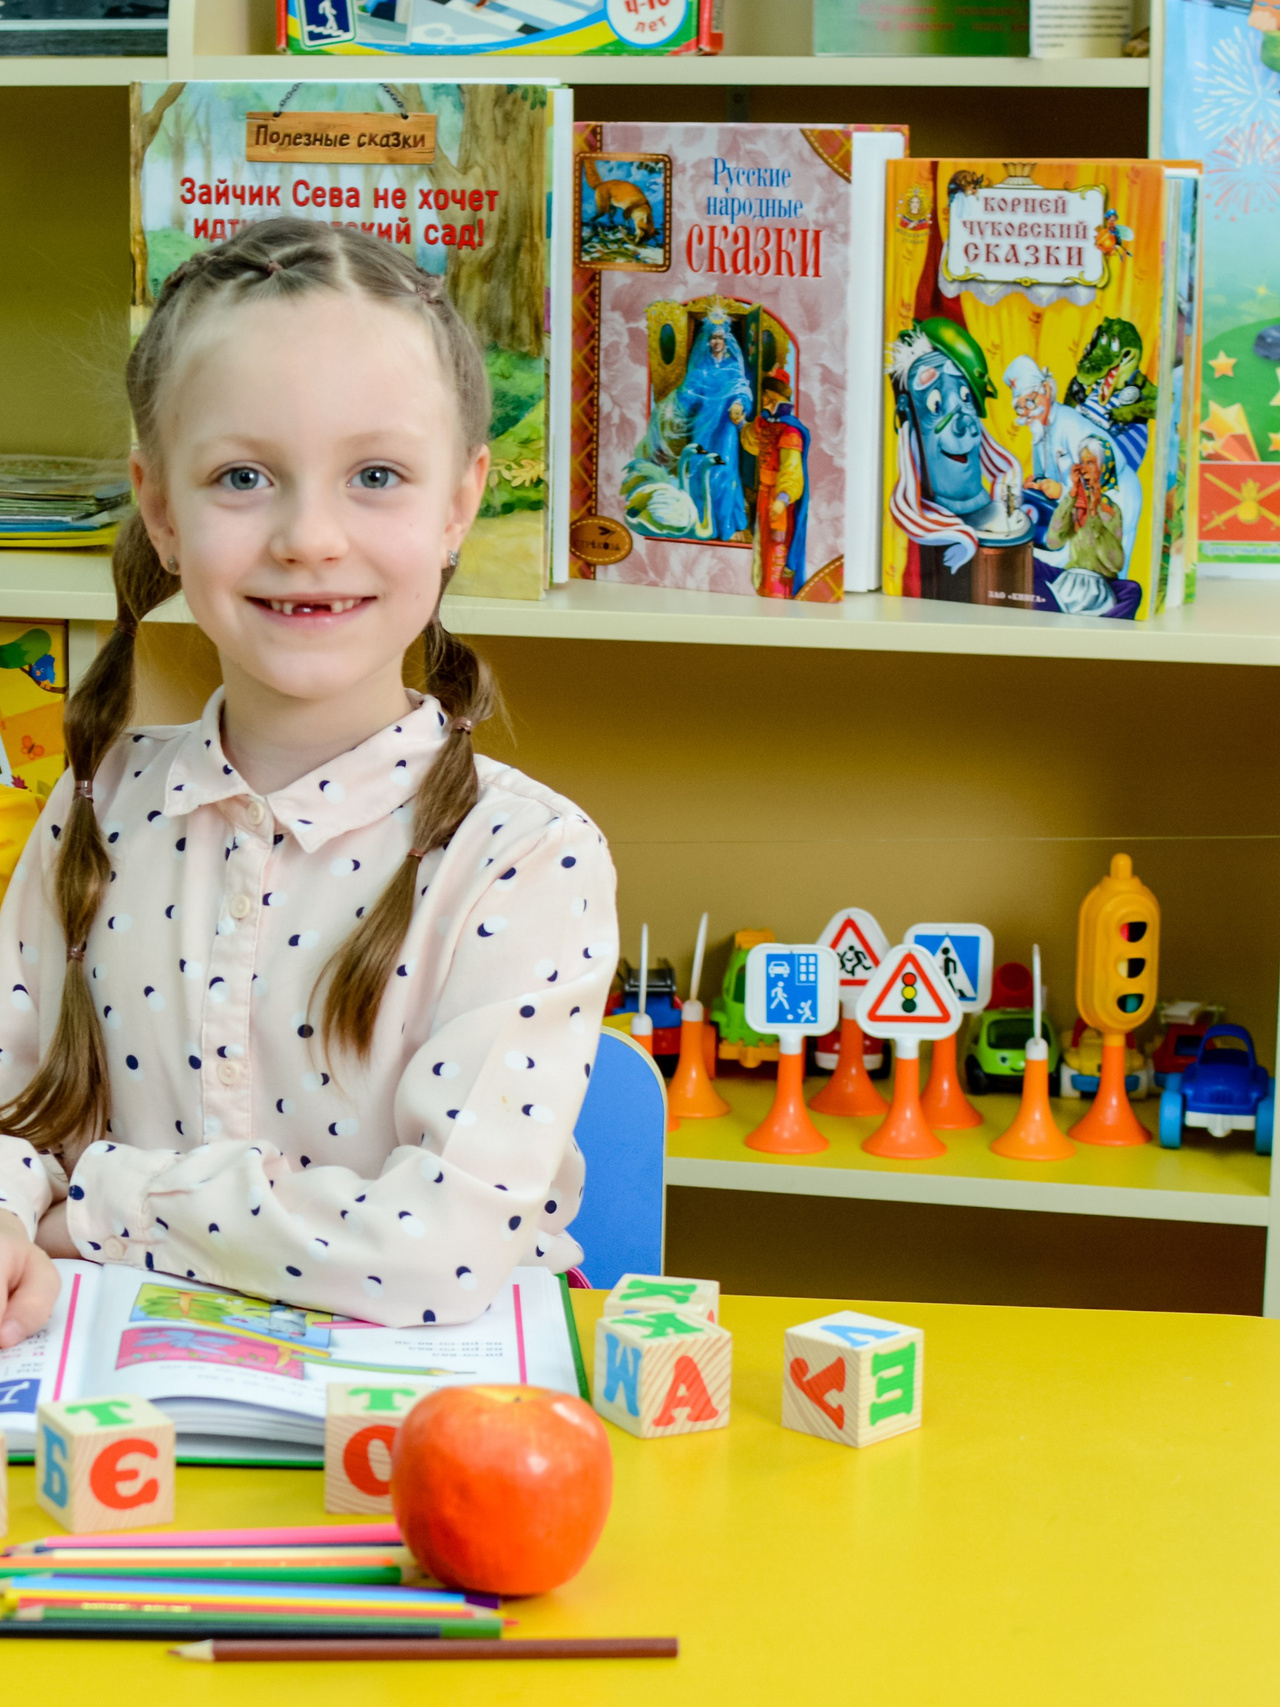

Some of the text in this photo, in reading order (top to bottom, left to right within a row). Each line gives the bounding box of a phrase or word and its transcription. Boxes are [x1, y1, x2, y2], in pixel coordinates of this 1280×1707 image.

[634, 15, 667, 33] лет
[255, 125, 426, 149] Полезные сказки
[712, 157, 792, 192] Русские
[180, 177, 500, 211] Зайчик Сева не хочет
[983, 194, 1067, 215] КОРНЕЙ
[706, 195, 803, 224] народные
[424, 219, 485, 250] сад!
[962, 218, 1089, 240] ЧУКОВСКИЙ
[963, 242, 1084, 267] СКАЗКИ
[347, 1388, 417, 1411] Т
[652, 1354, 719, 1427] А
[64, 1400, 134, 1426] Т
